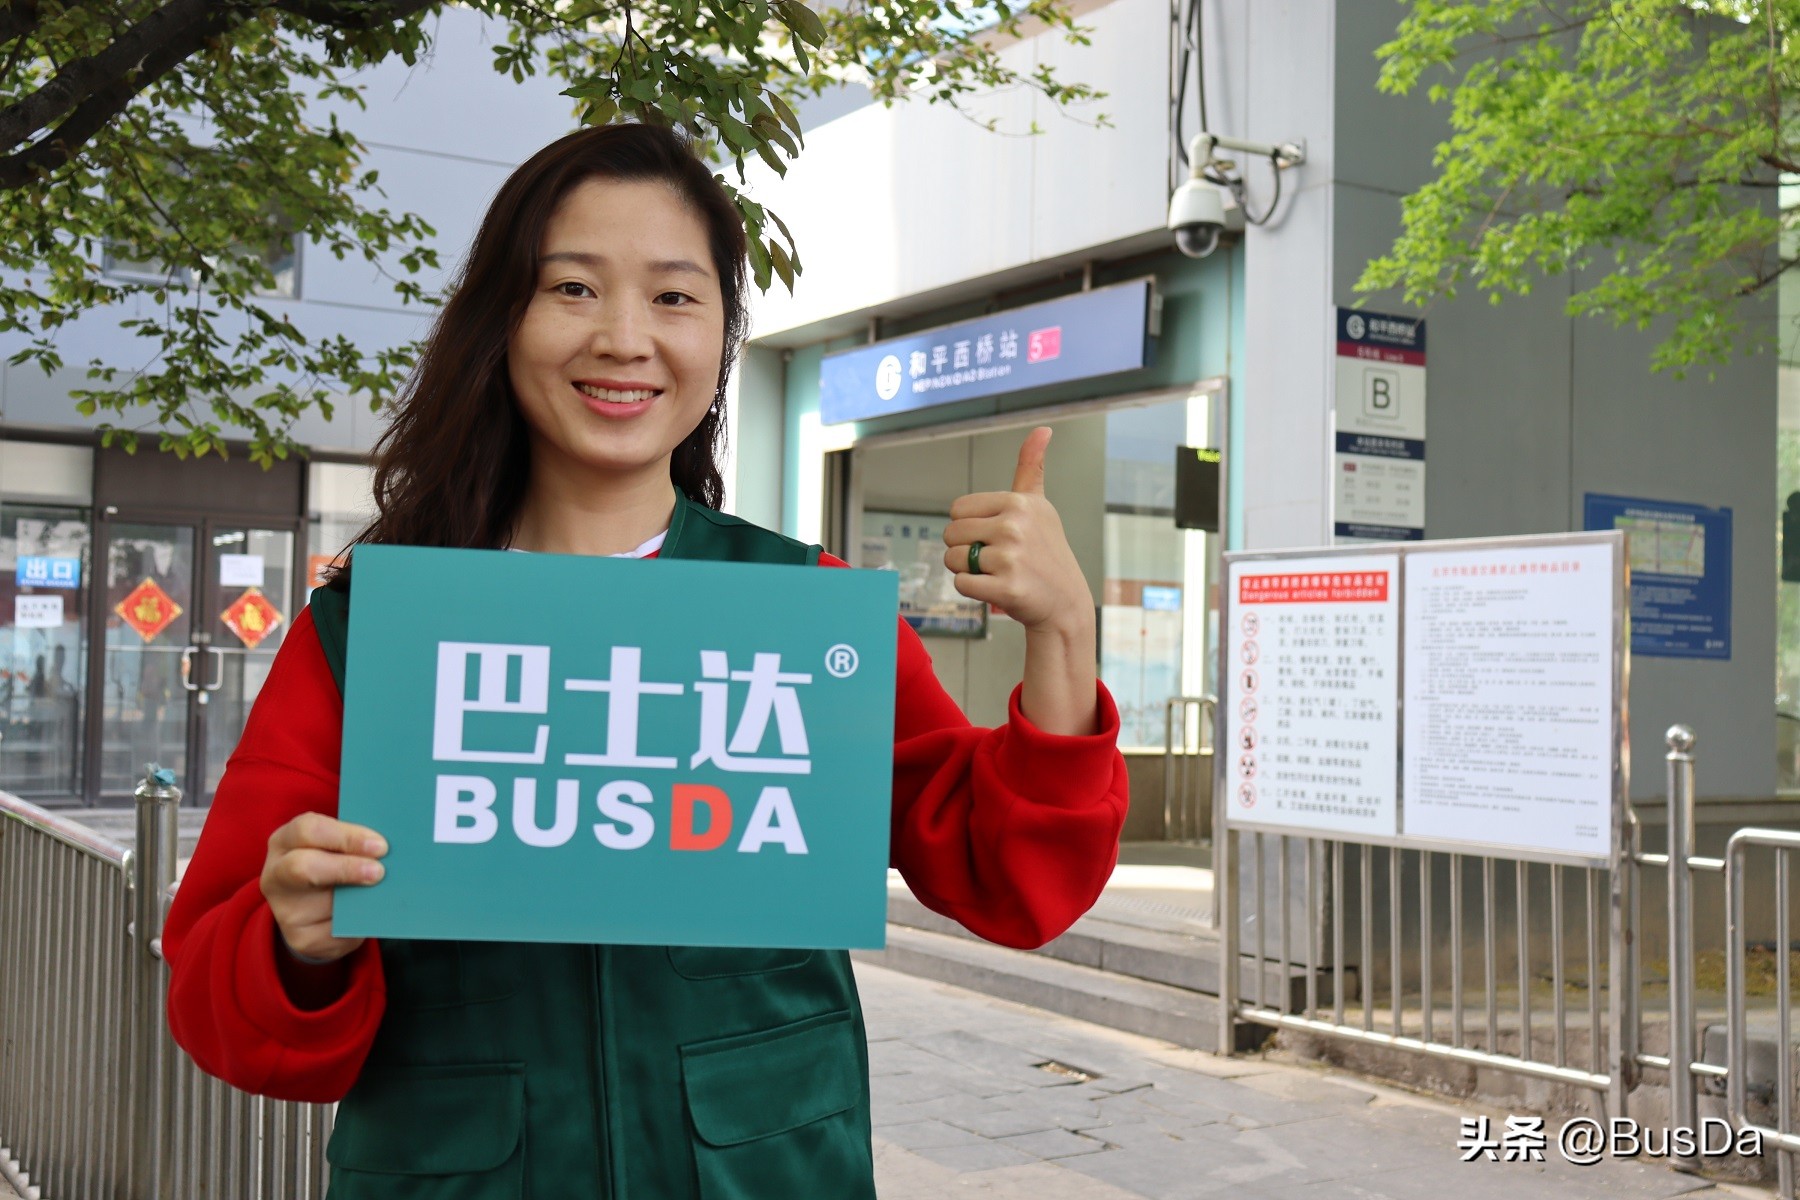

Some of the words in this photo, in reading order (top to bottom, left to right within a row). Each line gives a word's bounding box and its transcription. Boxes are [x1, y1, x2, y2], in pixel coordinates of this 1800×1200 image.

[908, 328, 1018, 379] 和平西桥站
[1030, 333, 1043, 360] 5
[1372, 378, 1390, 409] B
[25, 558, 73, 580] 出口
[1241, 590, 1290, 602] Dangerous
[432, 640, 813, 775] 巴士达
[433, 773, 809, 855] BUSDA
